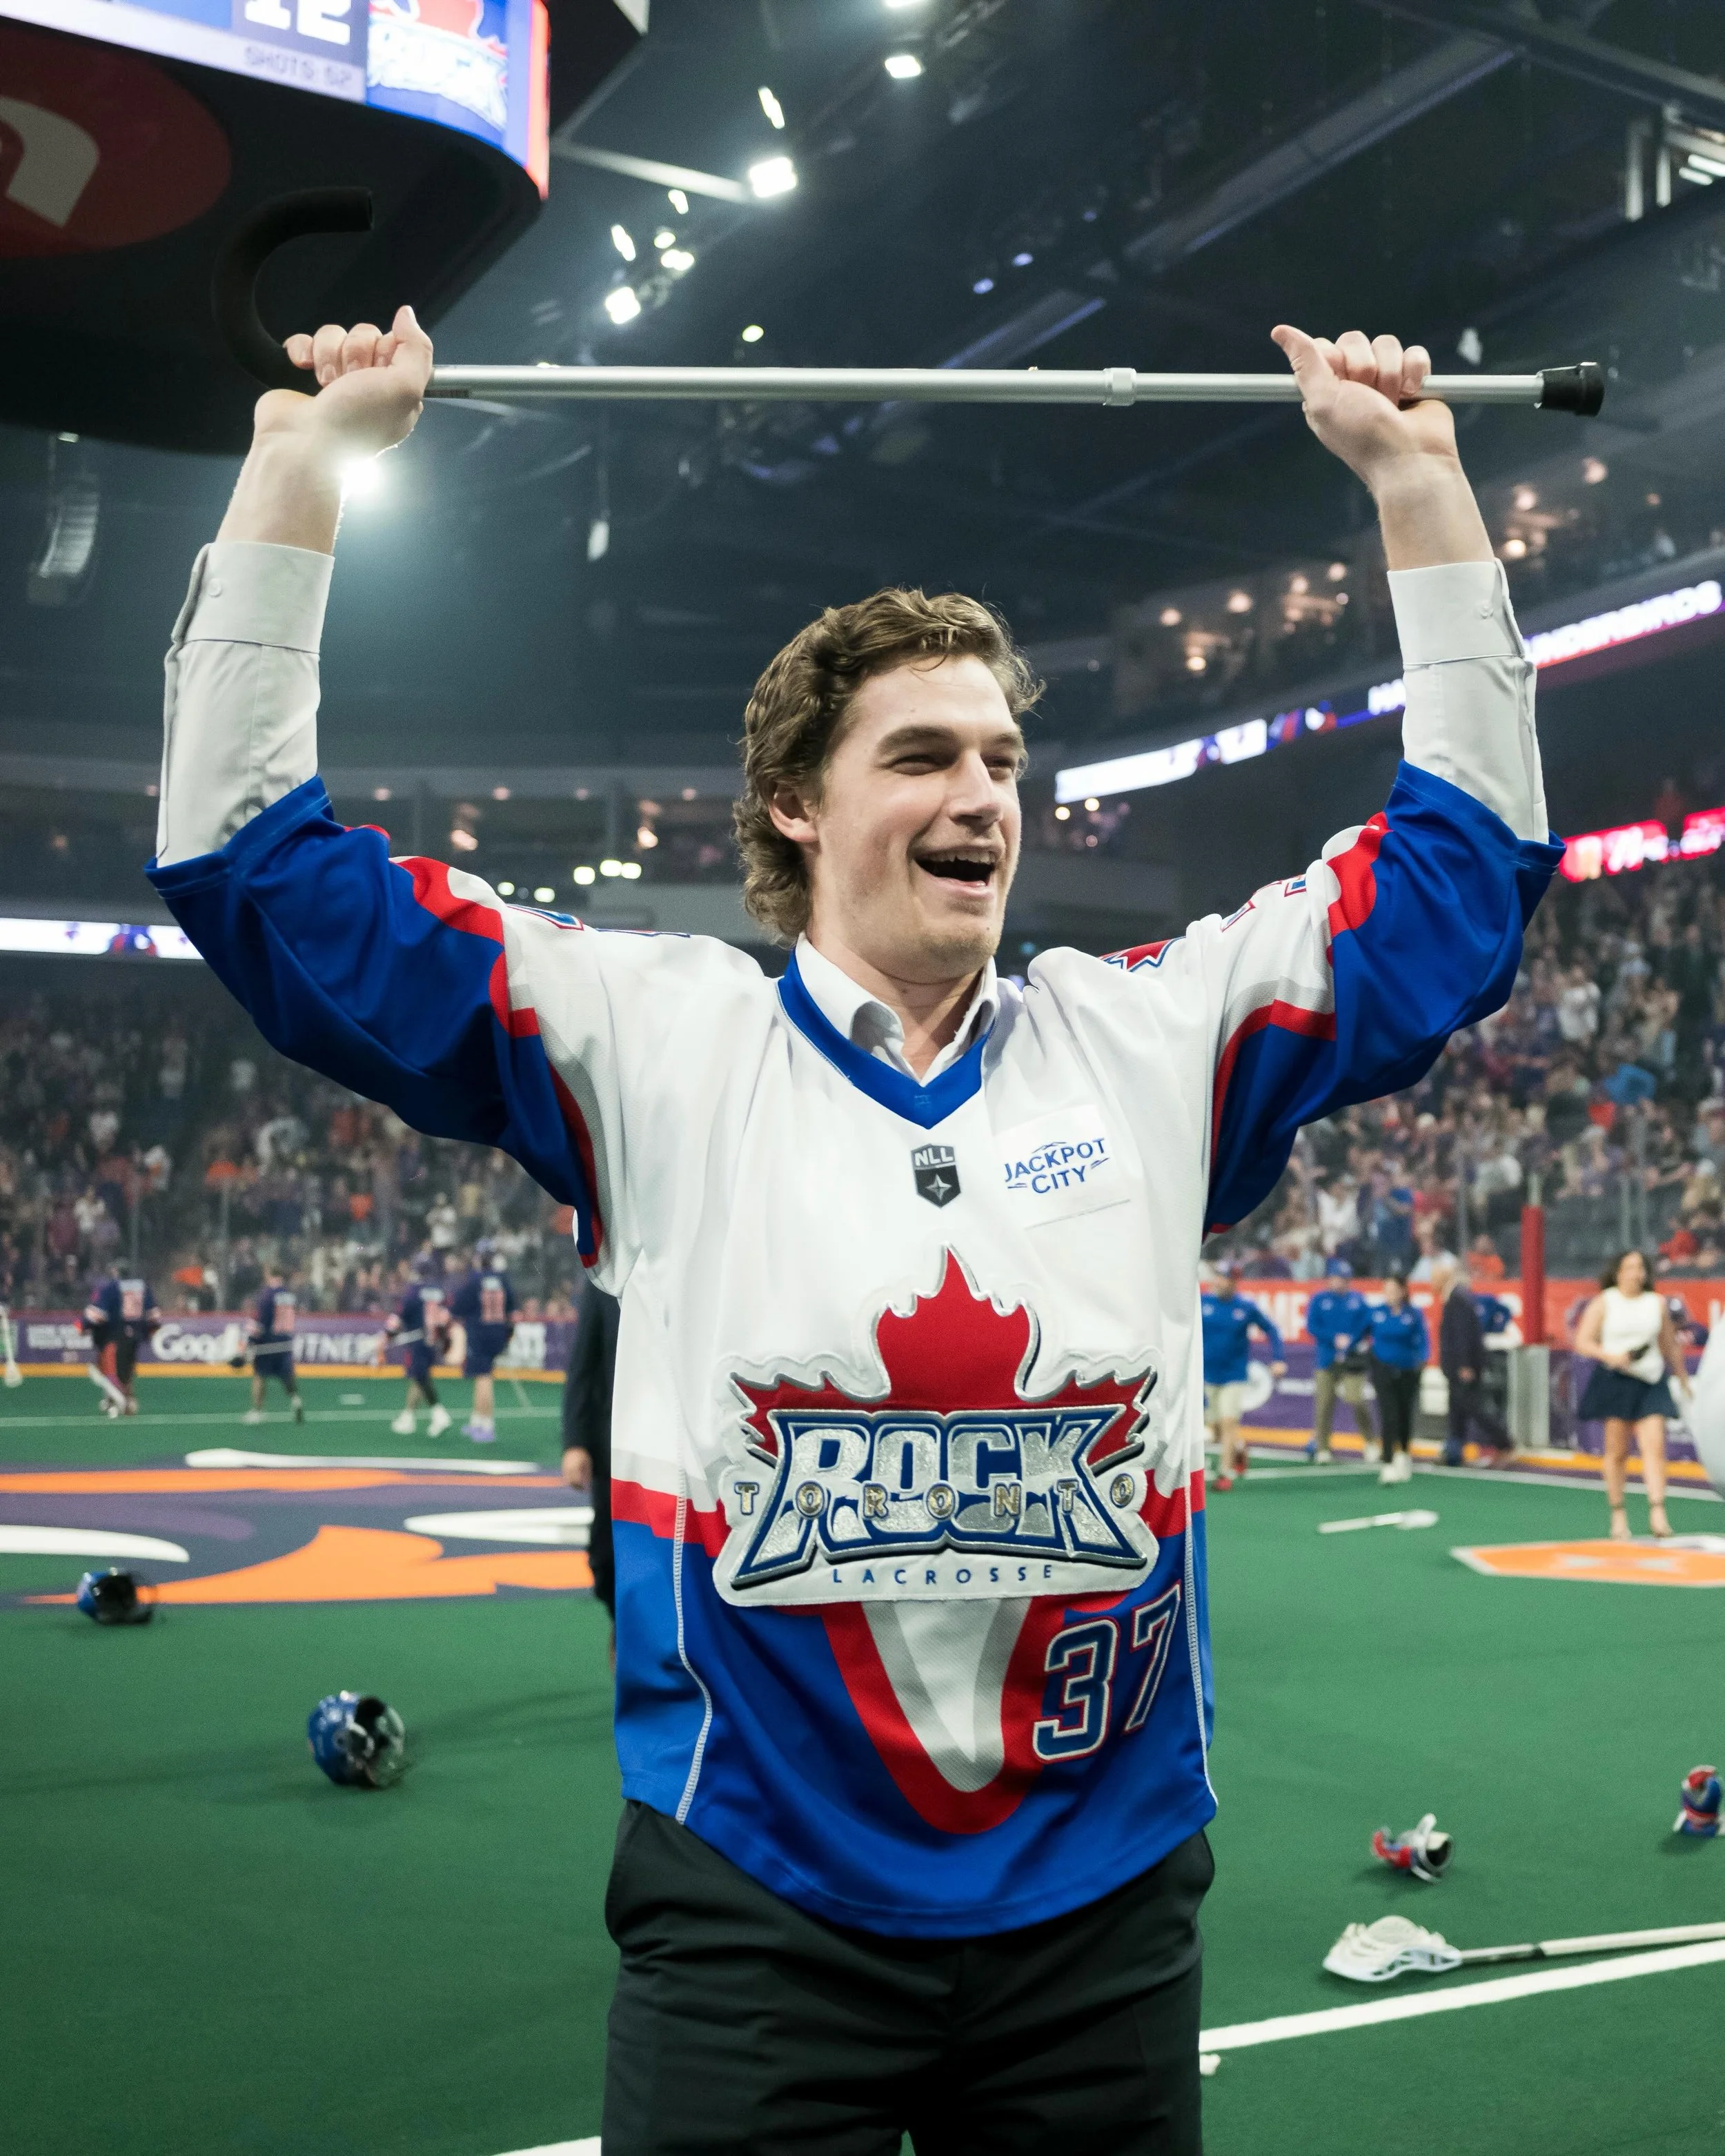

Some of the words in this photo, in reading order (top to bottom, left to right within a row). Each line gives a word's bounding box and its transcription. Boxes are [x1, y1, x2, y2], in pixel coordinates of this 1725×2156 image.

[914, 1146, 954, 1167] NLL
[1004, 1137, 1106, 1183] JACKPOT
[1031, 1165, 1087, 1194] CITY
[733, 1472, 1137, 1519] TORONTO
[744, 1416, 1135, 1570] ROCK
[833, 1563, 1052, 1585] LACROSSE
[1032, 1581, 1181, 1761] 37
